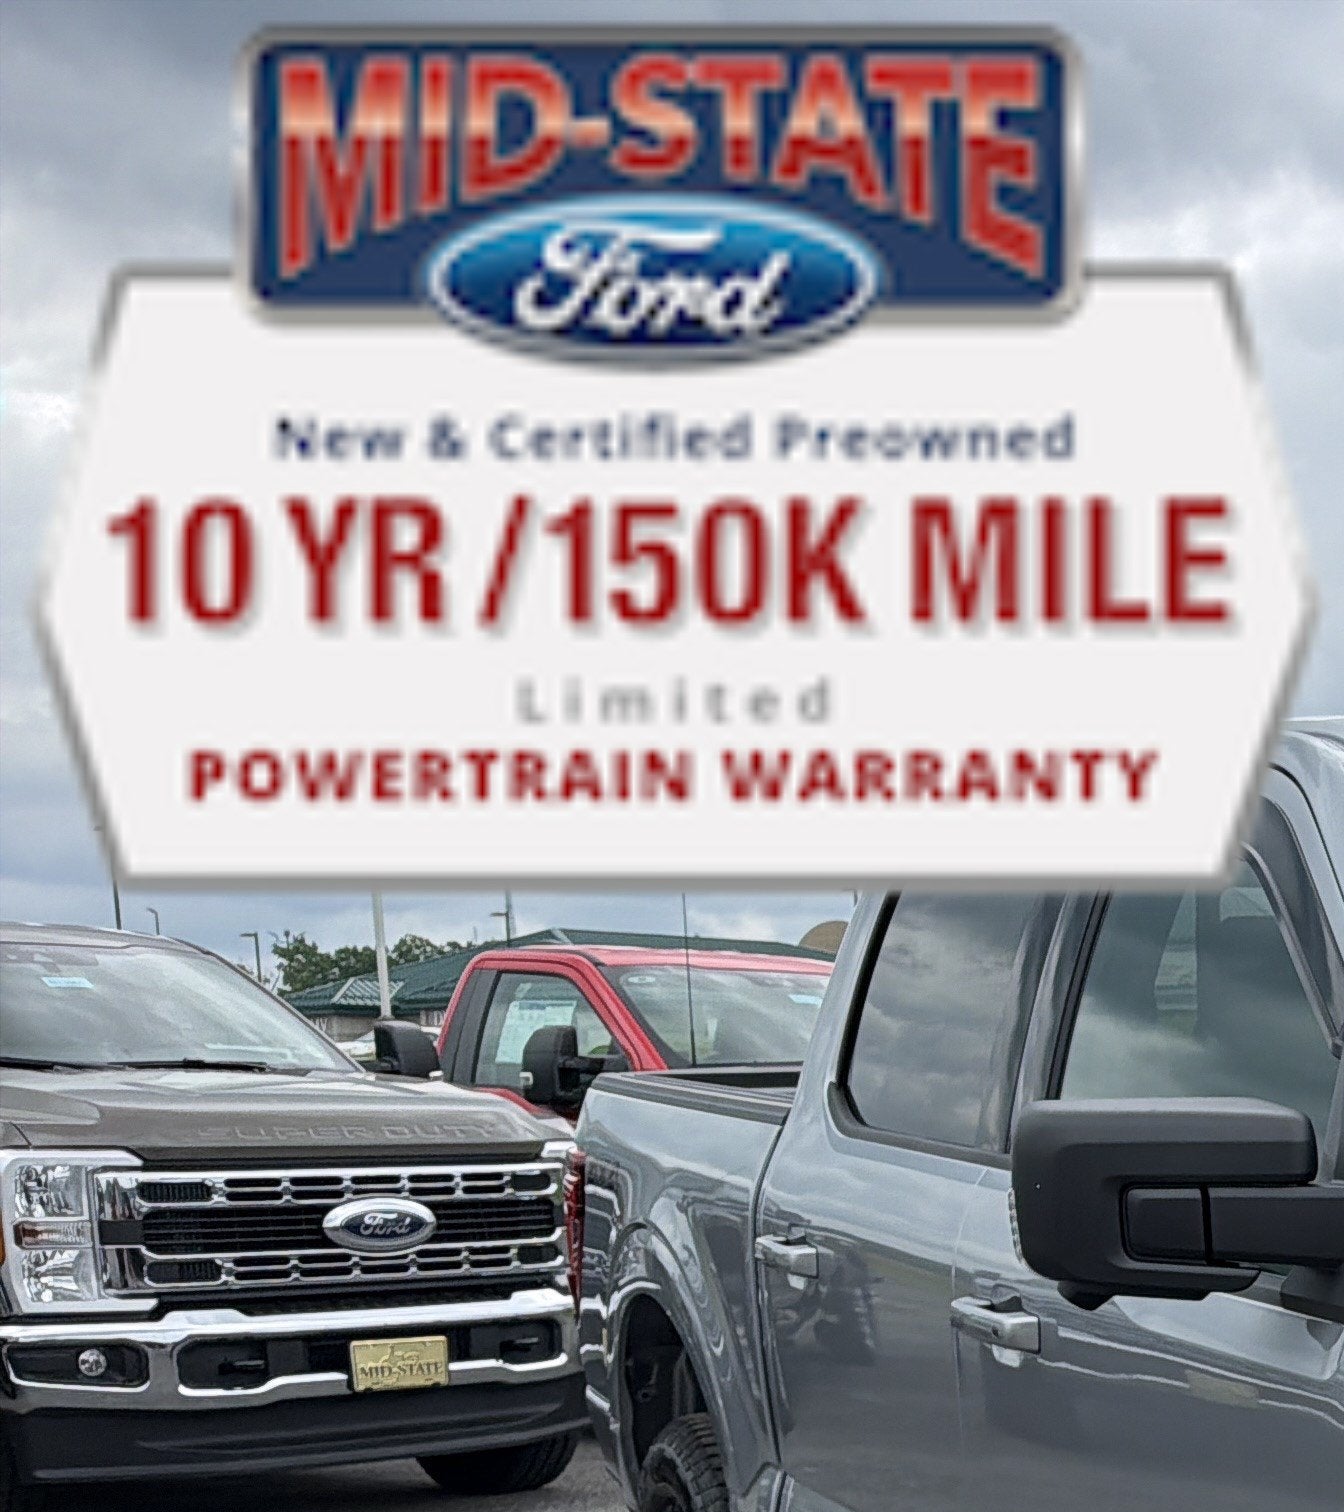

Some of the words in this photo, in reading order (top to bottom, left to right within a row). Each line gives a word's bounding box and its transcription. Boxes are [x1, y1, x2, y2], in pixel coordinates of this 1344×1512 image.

[198, 1125, 372, 1140] SUPER
[382, 1122, 501, 1140] DUTY
[360, 1212, 411, 1235] Ford
[360, 1361, 440, 1378] MID-STATE
